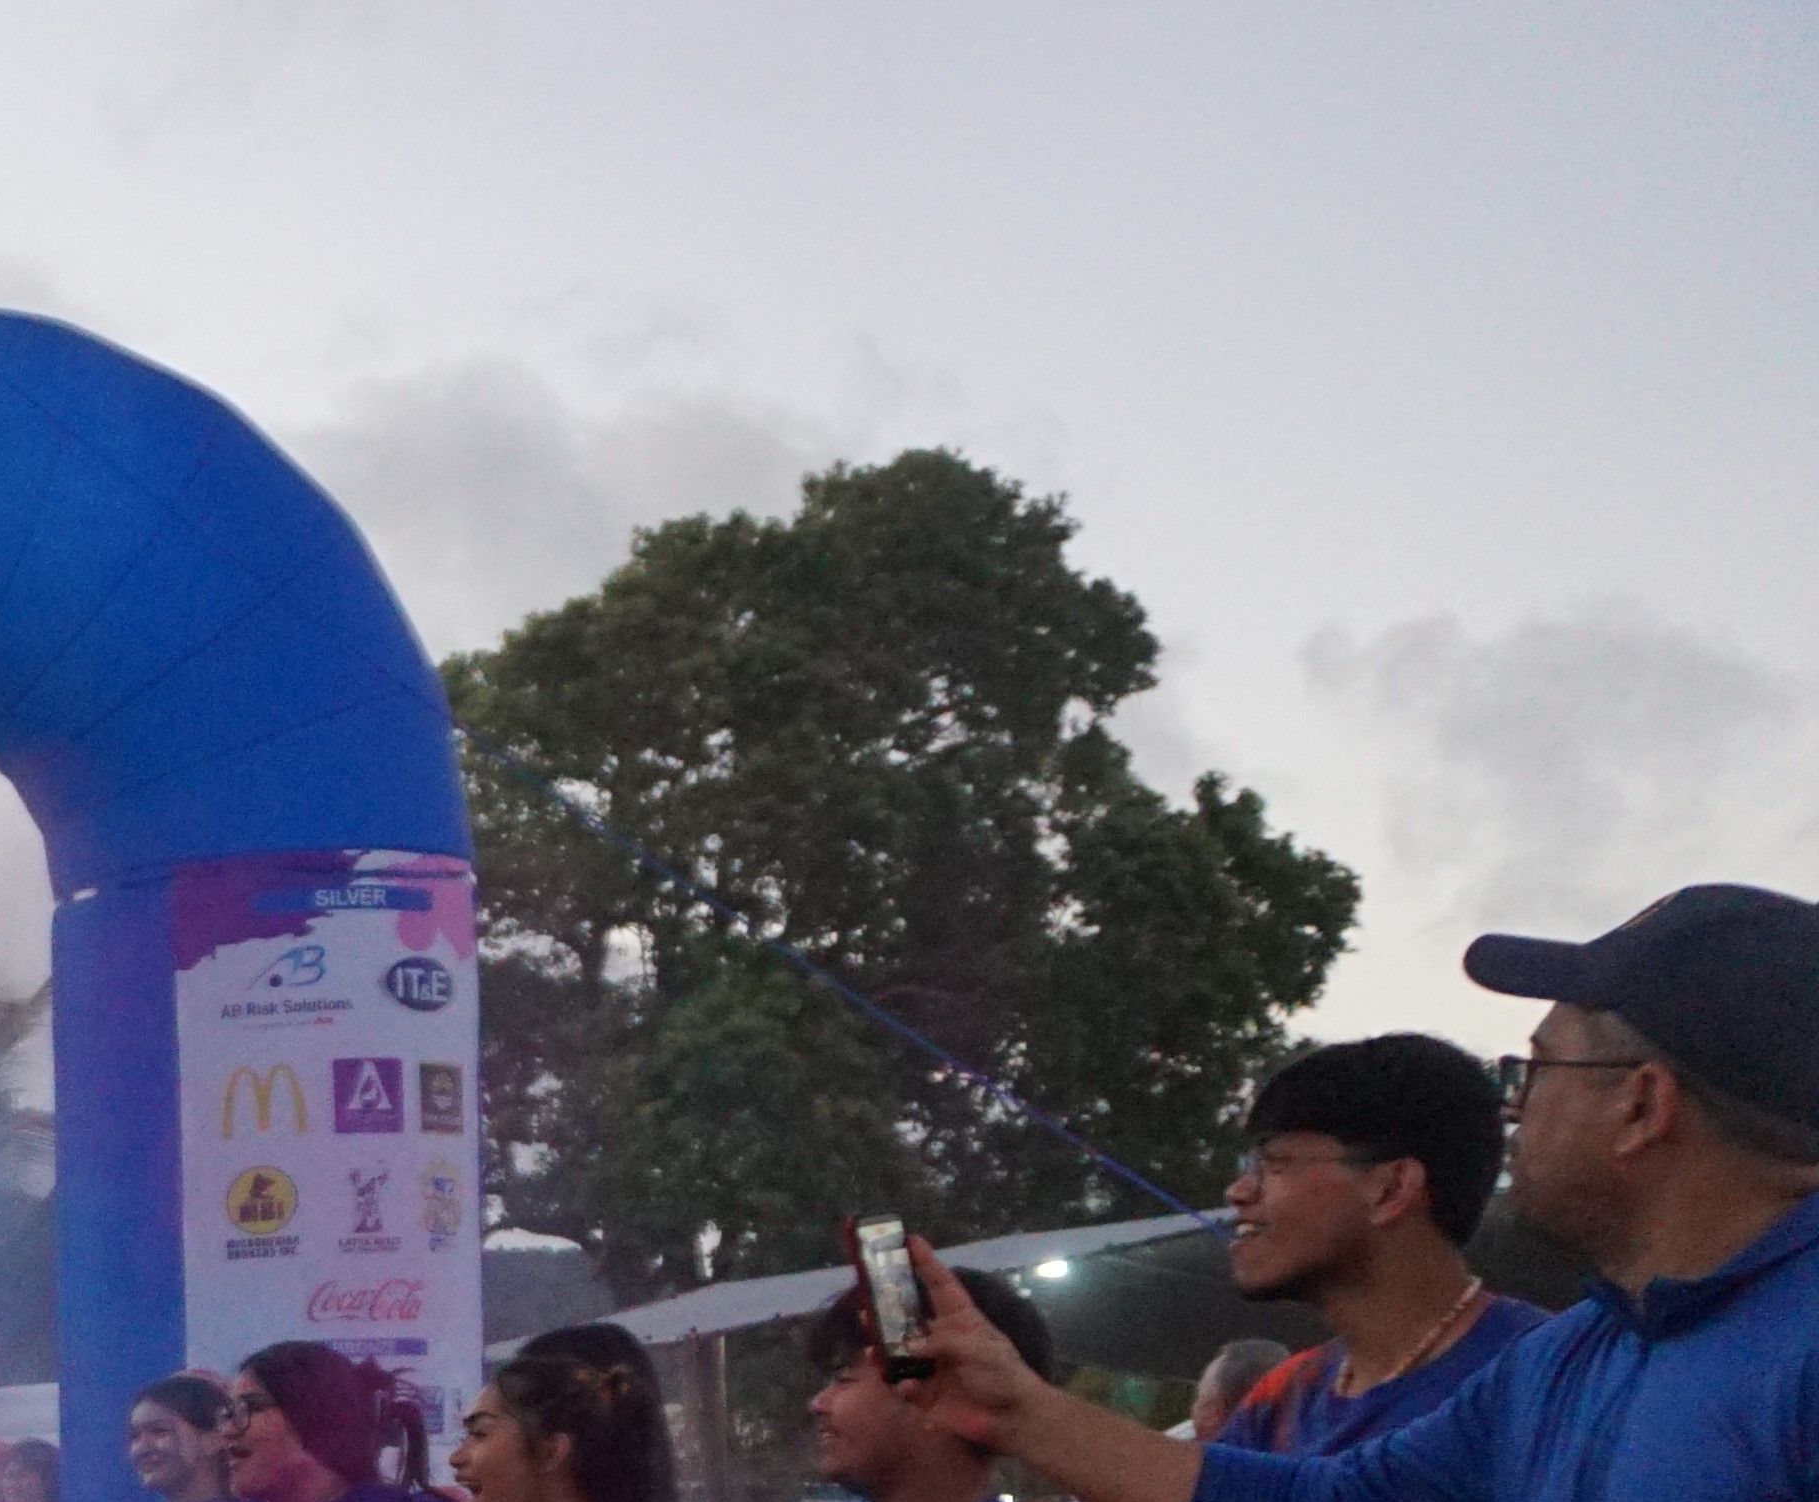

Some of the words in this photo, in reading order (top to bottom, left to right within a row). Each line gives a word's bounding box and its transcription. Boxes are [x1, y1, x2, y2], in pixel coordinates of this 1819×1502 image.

[314, 888, 387, 908] SILVER
[246, 1000, 279, 1016] Risk
[283, 997, 355, 1015] Solutions
